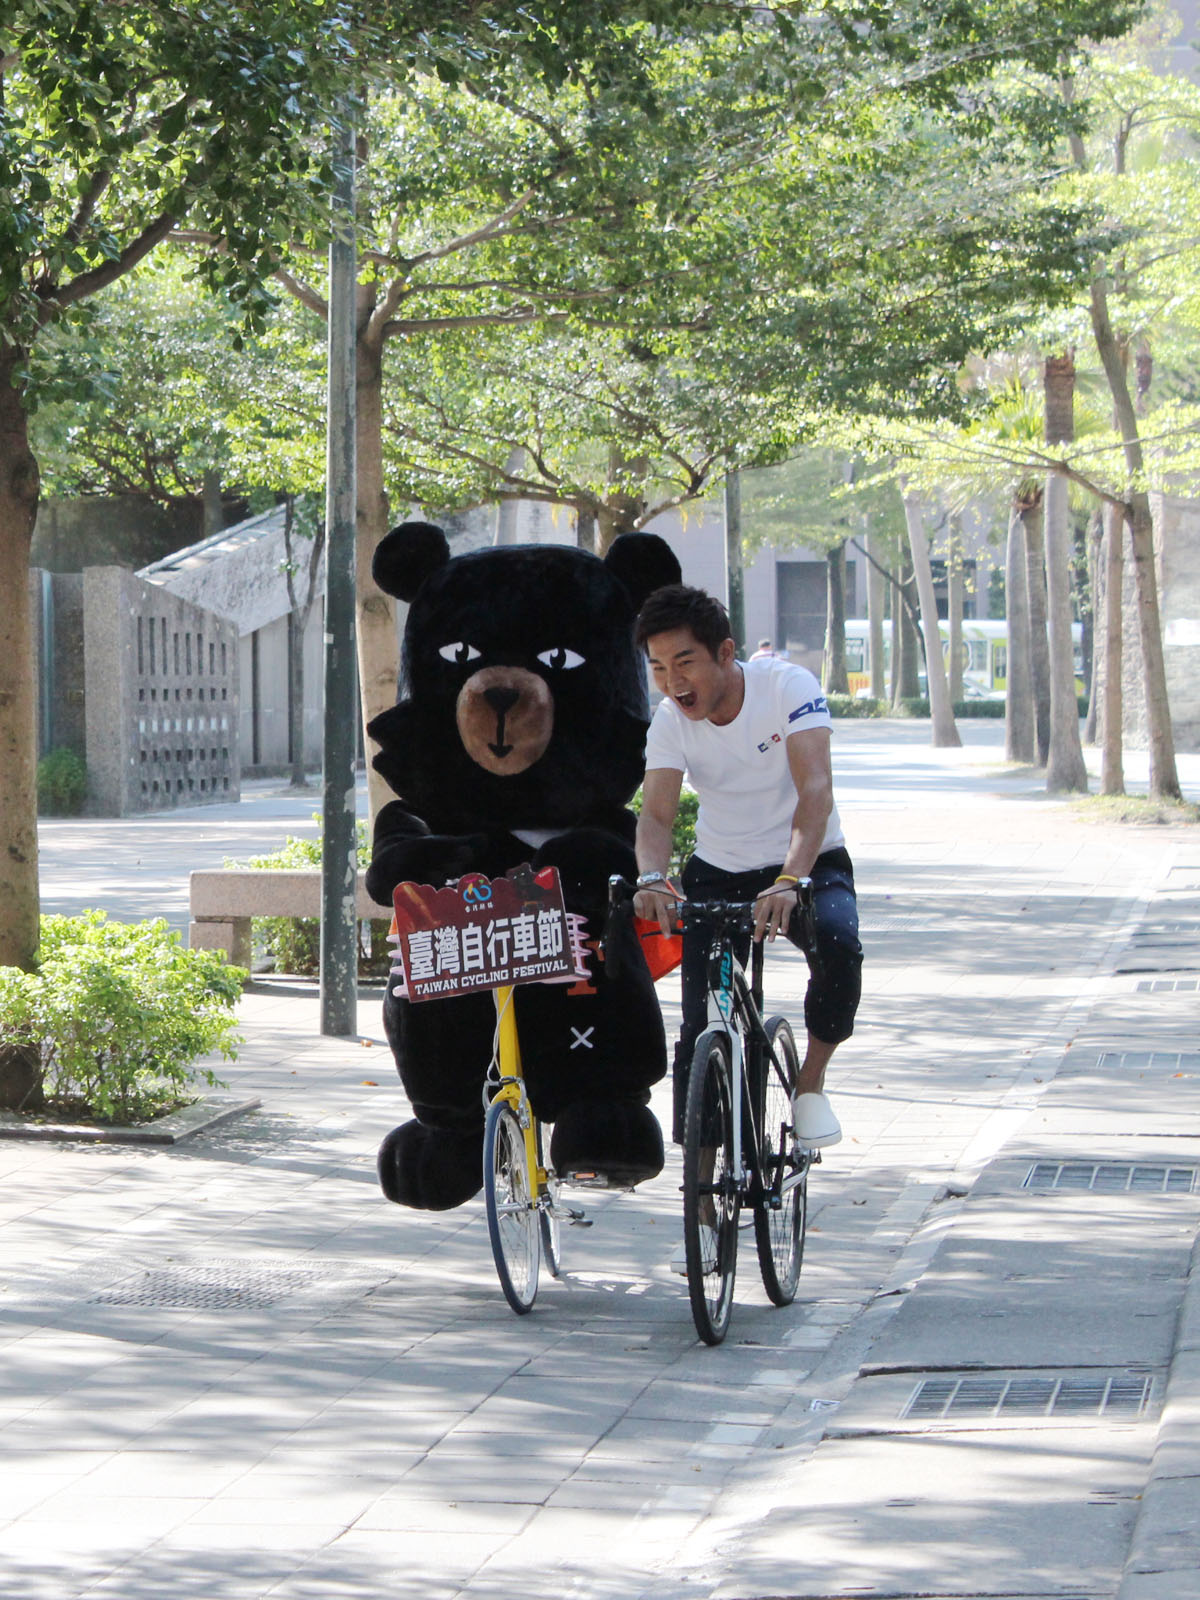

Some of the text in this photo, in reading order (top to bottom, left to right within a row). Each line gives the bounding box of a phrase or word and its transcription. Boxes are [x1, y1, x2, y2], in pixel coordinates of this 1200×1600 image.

[408, 908, 564, 981] 臺灣自行車節
[415, 959, 569, 995] TAIWAN CYCLING FESTIVAL
[719, 951, 732, 1017] GIANT
